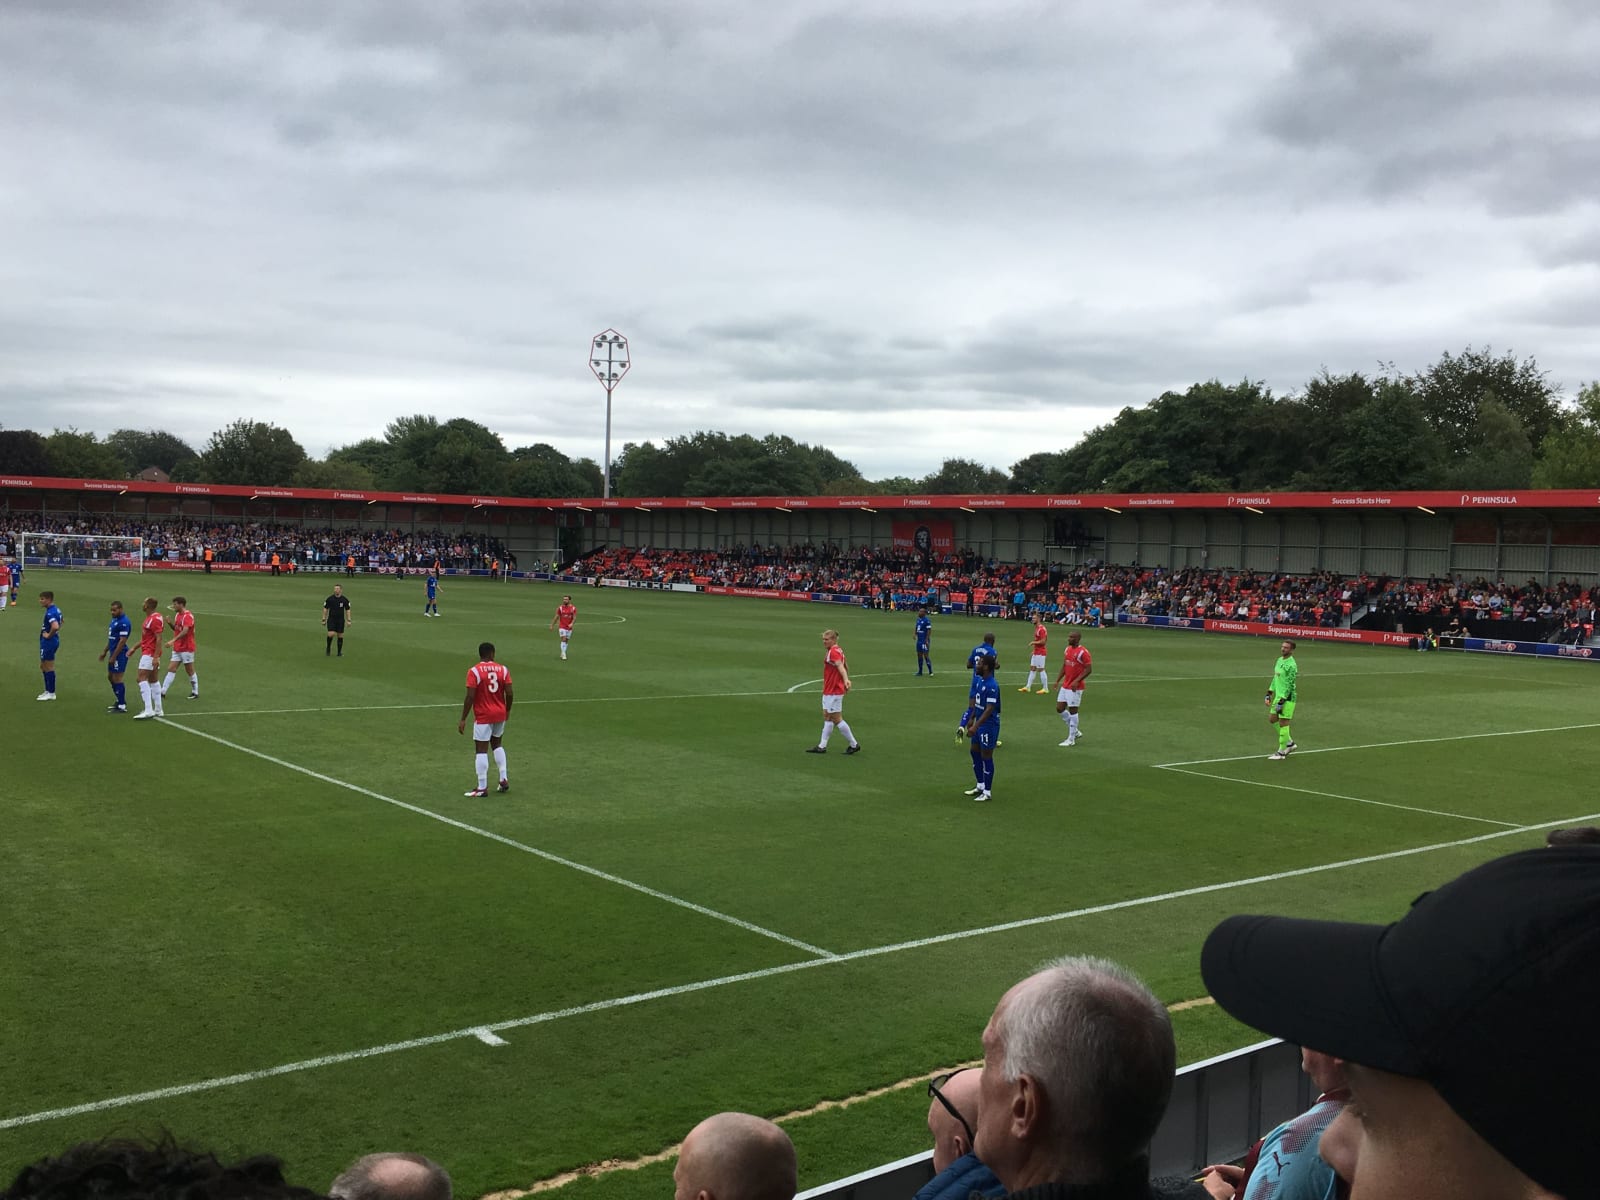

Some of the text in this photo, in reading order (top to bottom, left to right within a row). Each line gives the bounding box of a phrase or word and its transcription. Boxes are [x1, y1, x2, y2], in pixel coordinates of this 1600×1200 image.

[1268, 625, 1301, 635] Supporting
[1302, 628, 1315, 636] your
[1334, 631, 1362, 639] business
[488, 672, 498, 693] 3
[981, 733, 988, 742] 11
